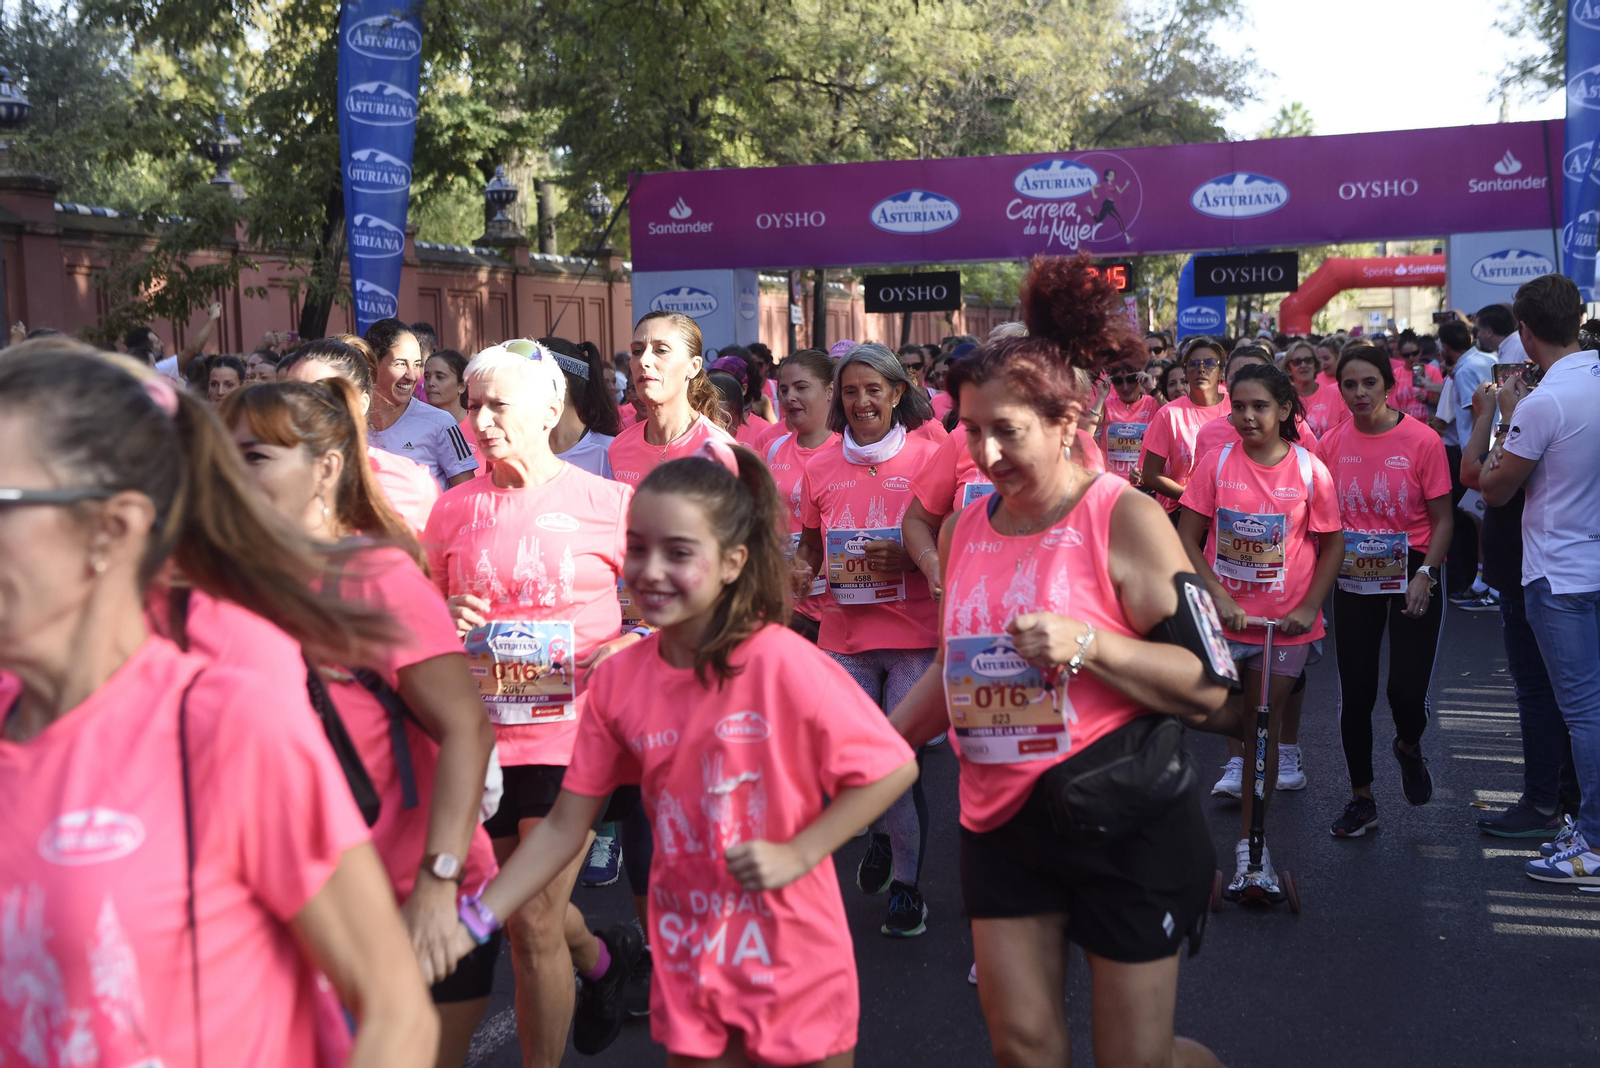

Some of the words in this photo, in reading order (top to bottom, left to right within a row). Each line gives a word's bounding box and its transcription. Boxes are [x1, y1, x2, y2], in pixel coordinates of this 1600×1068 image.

[350, 94, 413, 118] ASTURIANA
[352, 168, 407, 186] STURIANA
[1020, 176, 1093, 191] ASTURIANA
[1468, 175, 1548, 193] Santander
[1338, 178, 1419, 200] OYSHO
[1199, 191, 1281, 208] ASTURIANA
[877, 207, 954, 224] ASTURIANA
[1006, 198, 1077, 220] Carrera
[756, 211, 826, 229] OYSHO
[648, 221, 714, 235] Santander
[1023, 220, 1037, 235] de
[1039, 220, 1049, 235] la
[1047, 215, 1104, 250] Mujer
[1210, 265, 1284, 284] OYSHO
[1363, 265, 1393, 279] Sports
[1477, 260, 1548, 279] ASTURIANA
[879, 284, 948, 302] OYSHO
[656, 300, 713, 312] ASTURIANA
[1107, 459, 1138, 472] SUM
[615, 470, 640, 481] OYSHO
[828, 479, 857, 491] OYSHO
[1216, 479, 1247, 490] OYSHO
[1234, 523, 1264, 534] ASTURIANA
[846, 542, 864, 551] ASTUR
[1232, 538, 1264, 554] 016
[1356, 557, 1386, 568] 016
[491, 640, 538, 651] ASTURIANA
[491, 661, 538, 681] 016
[975, 658, 1028, 671] ASTURIANA
[502, 685, 527, 694] 2067
[974, 685, 1027, 709] 016
[991, 714, 1011, 725] 823
[995, 728, 1003, 736] DE
[1004, 727, 1013, 735] LA
